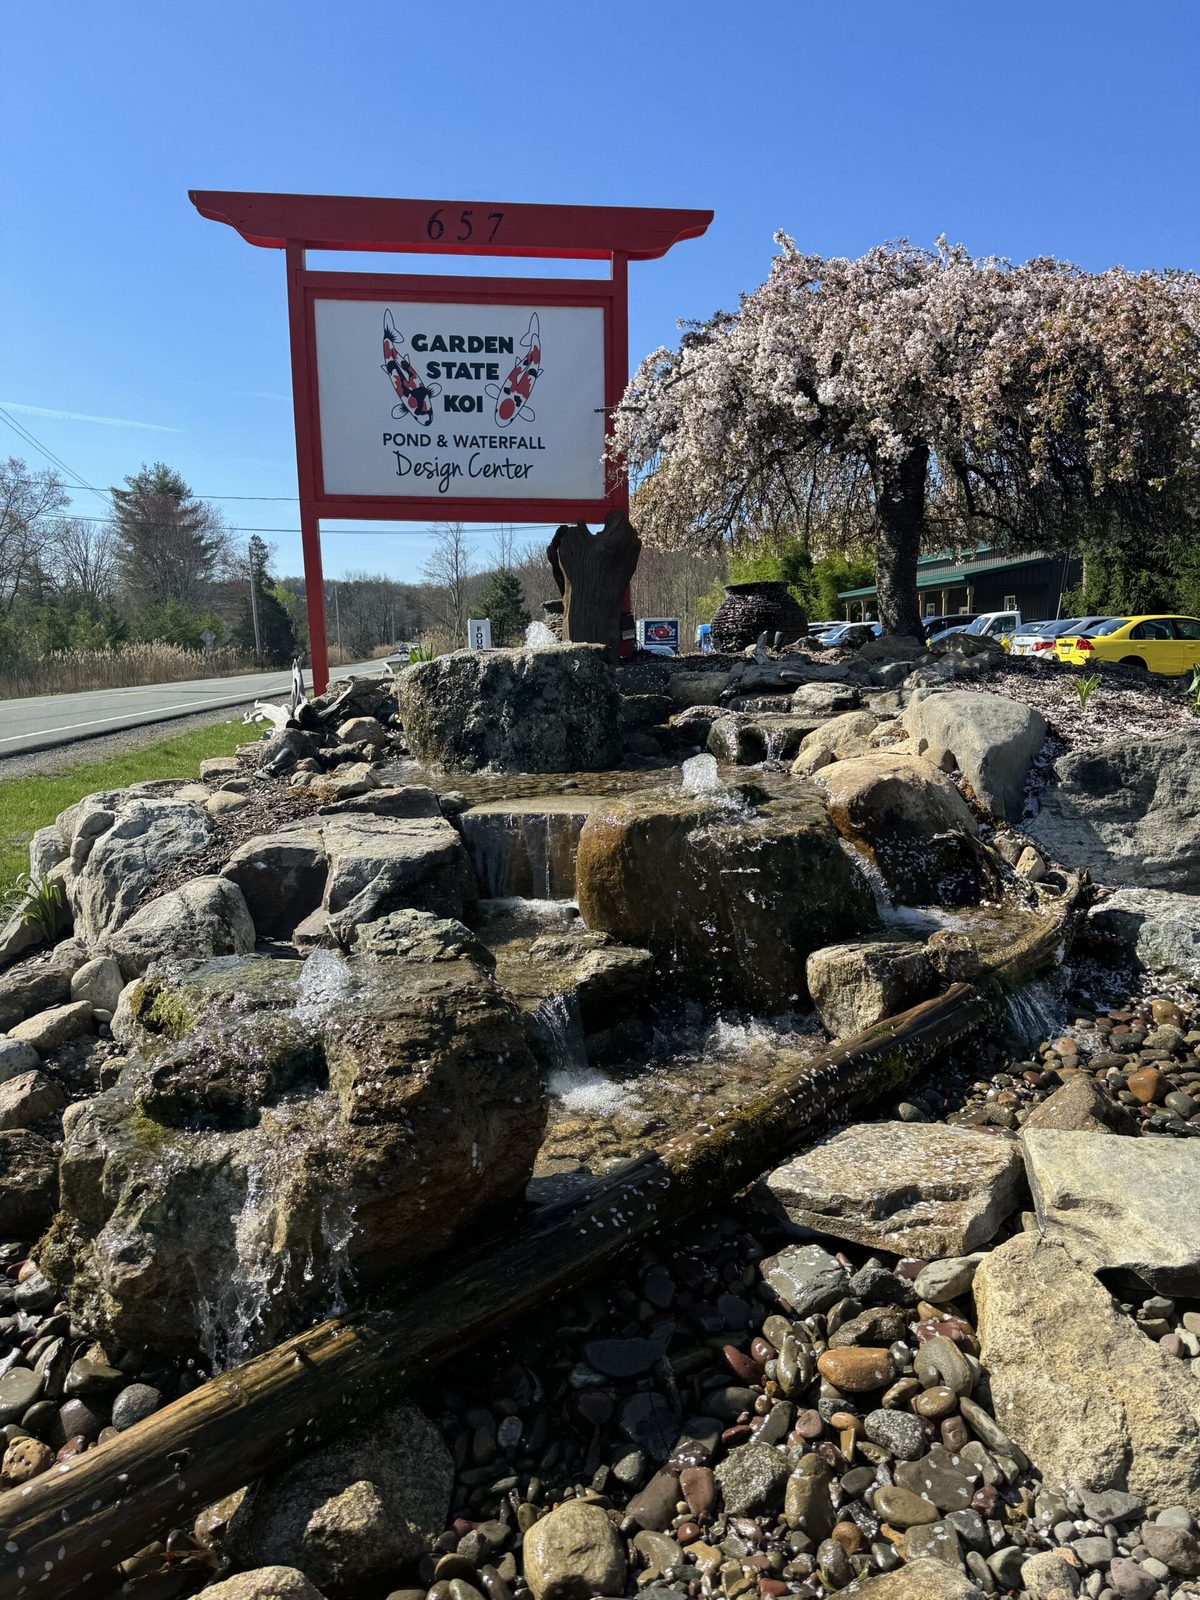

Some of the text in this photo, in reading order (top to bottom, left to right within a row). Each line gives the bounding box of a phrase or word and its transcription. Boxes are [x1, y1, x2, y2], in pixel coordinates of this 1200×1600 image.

[427, 208, 505, 243] 657
[411, 333, 514, 354] GARDEN
[426, 361, 500, 380] STATE
[443, 394, 484, 413] KOI
[382, 433, 546, 450] POND & WATERFALL
[392, 450, 534, 493] Design Center
